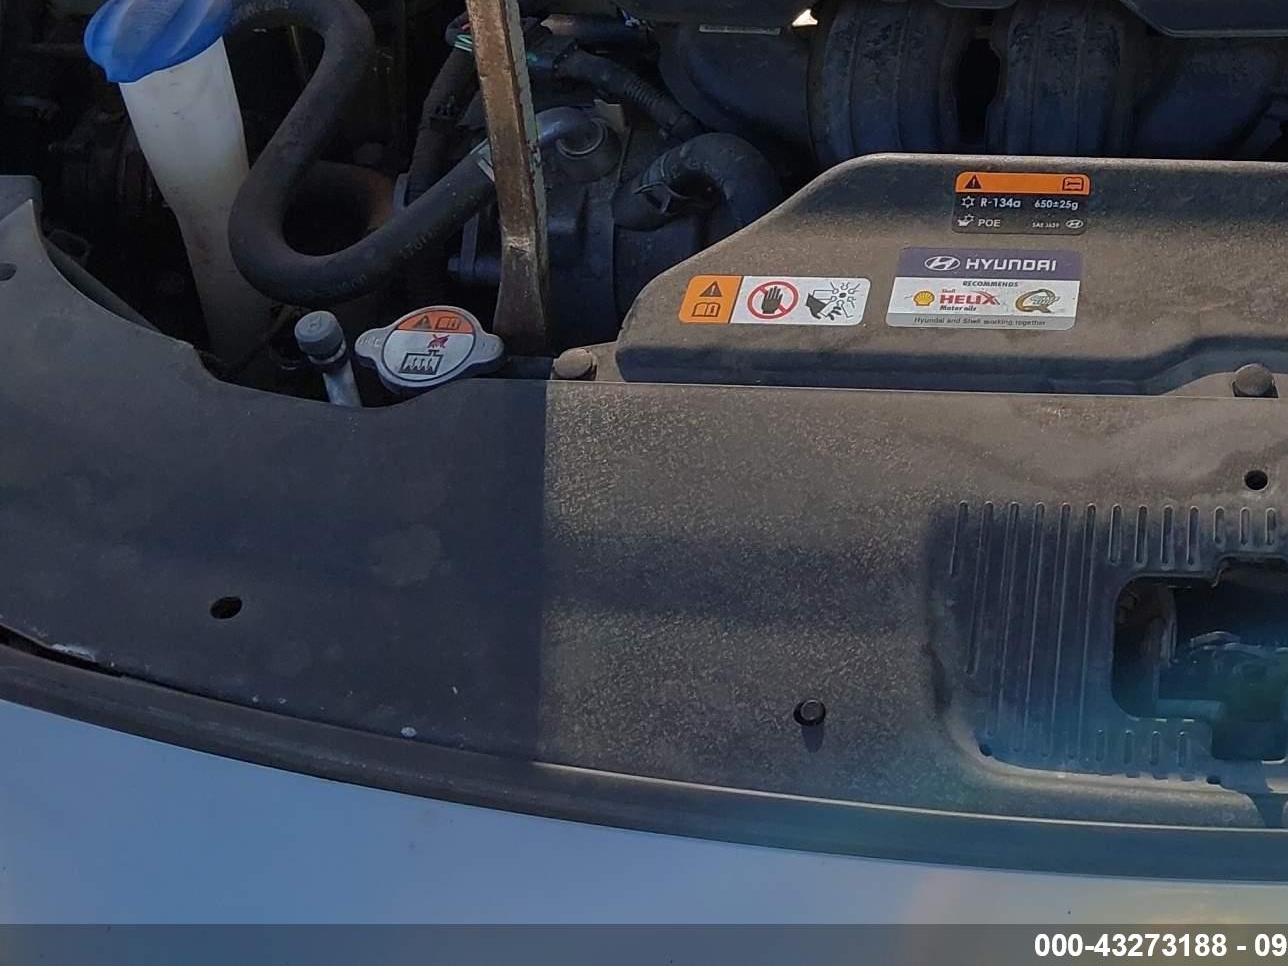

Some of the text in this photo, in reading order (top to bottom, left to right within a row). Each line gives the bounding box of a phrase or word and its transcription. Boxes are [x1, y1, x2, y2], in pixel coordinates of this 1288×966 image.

[980, 197, 1079, 211] R-134a 650±25g
[978, 218, 1001, 228] POE
[965, 258, 1057, 272] HYUNDAI
[962, 280, 1019, 288] RECOMMENDS
[939, 292, 999, 306] HELIX
[913, 316, 945, 325] Hyundai
[983, 319, 1012, 327] working
[1015, 319, 1046, 327] together
